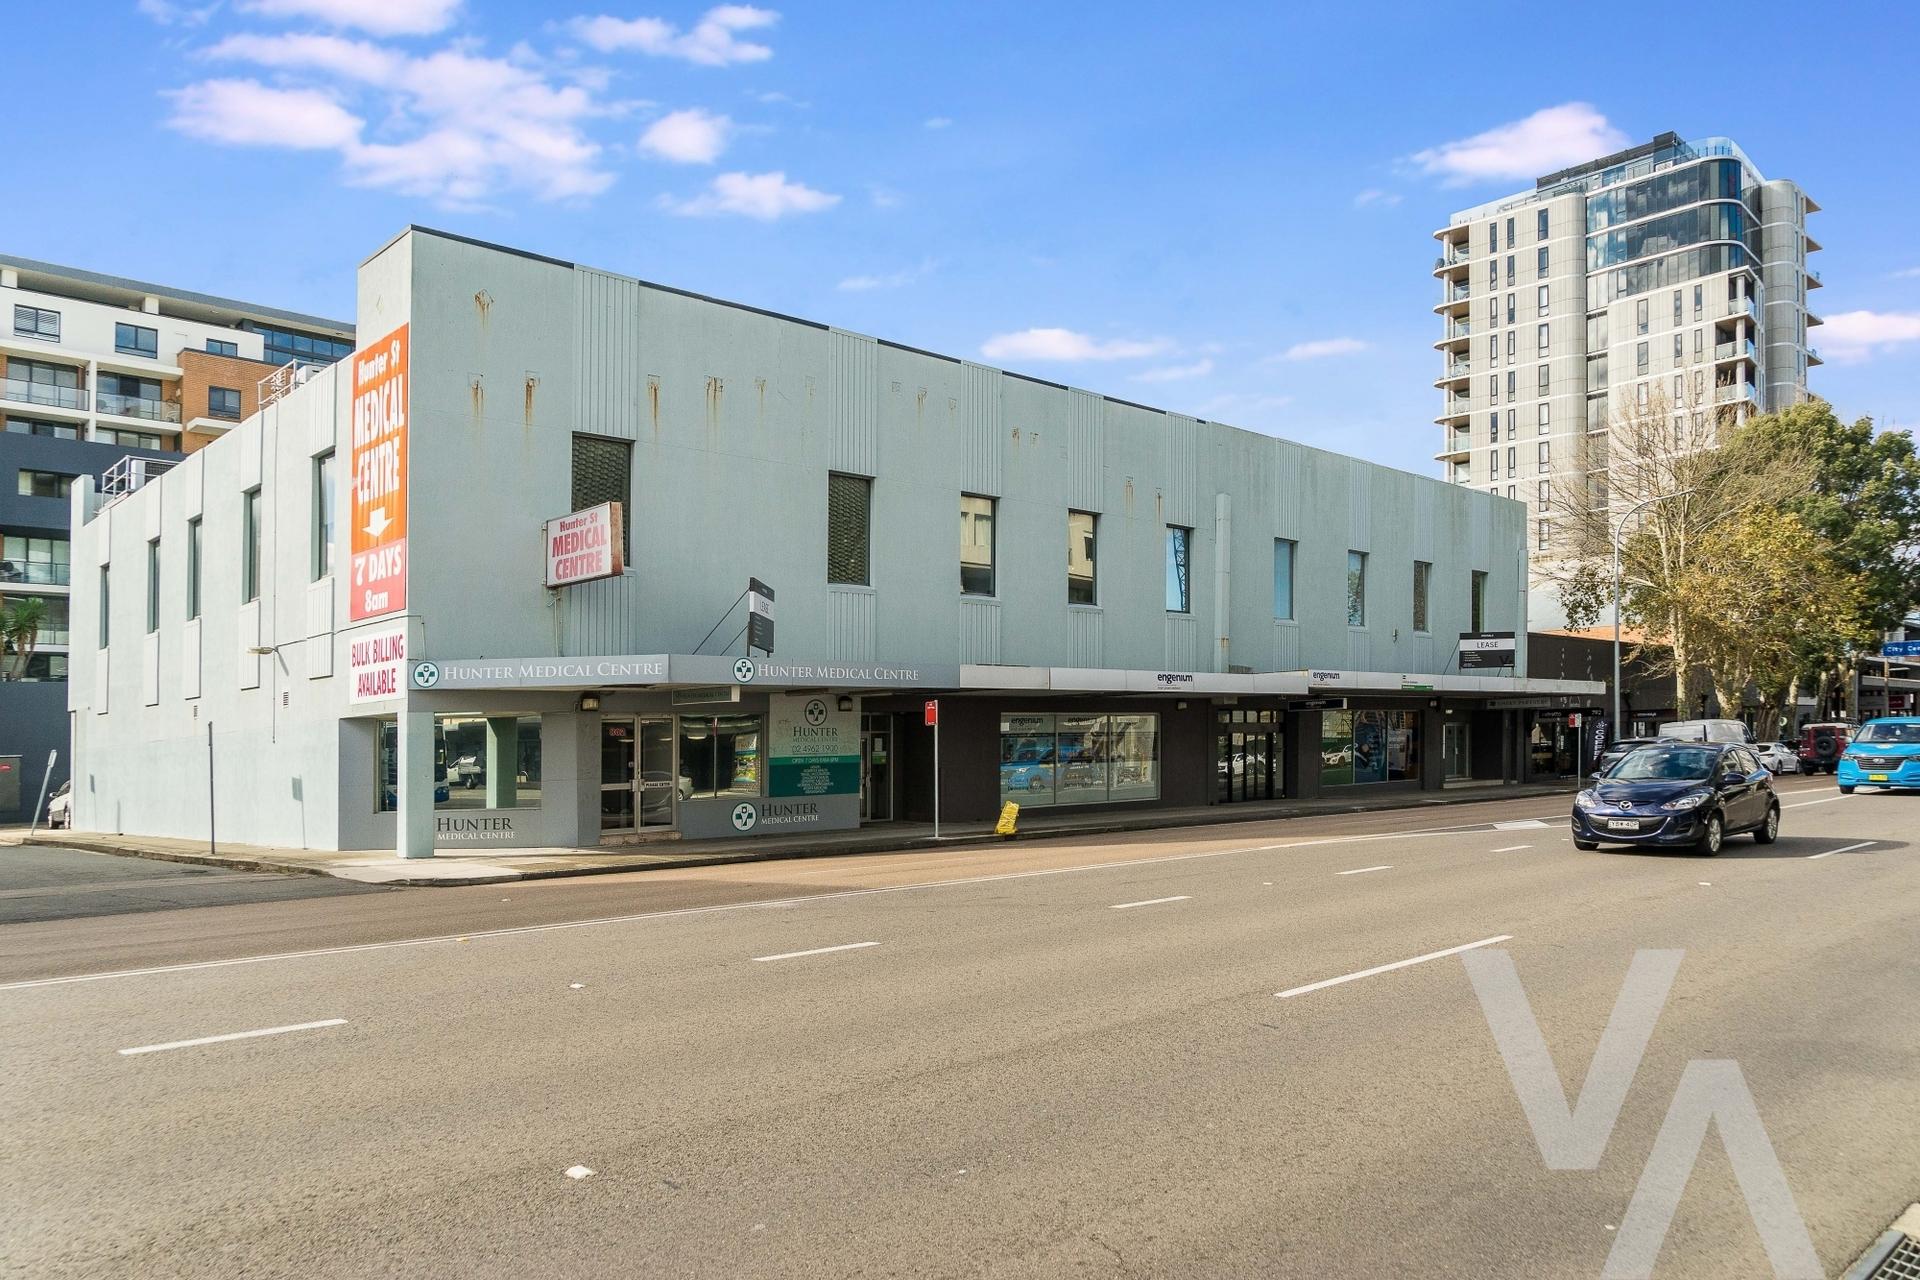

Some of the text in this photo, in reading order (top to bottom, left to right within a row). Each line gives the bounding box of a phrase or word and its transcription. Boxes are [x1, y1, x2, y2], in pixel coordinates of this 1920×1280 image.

[358, 339, 400, 386] Hunter St
[353, 373, 405, 449] MEDICAL
[357, 435, 400, 505] CENTRE
[560, 512, 598, 532] Hunter St
[552, 524, 607, 557] MEDICAL
[354, 545, 402, 587] 7 DAYS
[555, 551, 603, 580] CENTRE
[364, 588, 389, 612] 8am
[351, 633, 404, 668] BULK BILLING
[1476, 641, 1499, 649] LEASE
[444, 662, 663, 681] HUNTER MEDICAL CENTRE
[758, 664, 919, 681] HUNTER MEDICAL CENTRE
[1157, 672, 1193, 684] engenium
[1312, 671, 1340, 681] engenium
[357, 668, 397, 697] AVAILABLE
[1011, 716, 1044, 726] engenium
[793, 727, 839, 737] HUNTER
[761, 814, 819, 825] MEDICAL CENTRE
[762, 803, 818, 817] HUNTER
[437, 817, 513, 832] HUNTER
[437, 831, 516, 841] MEDICAL CENTRE
